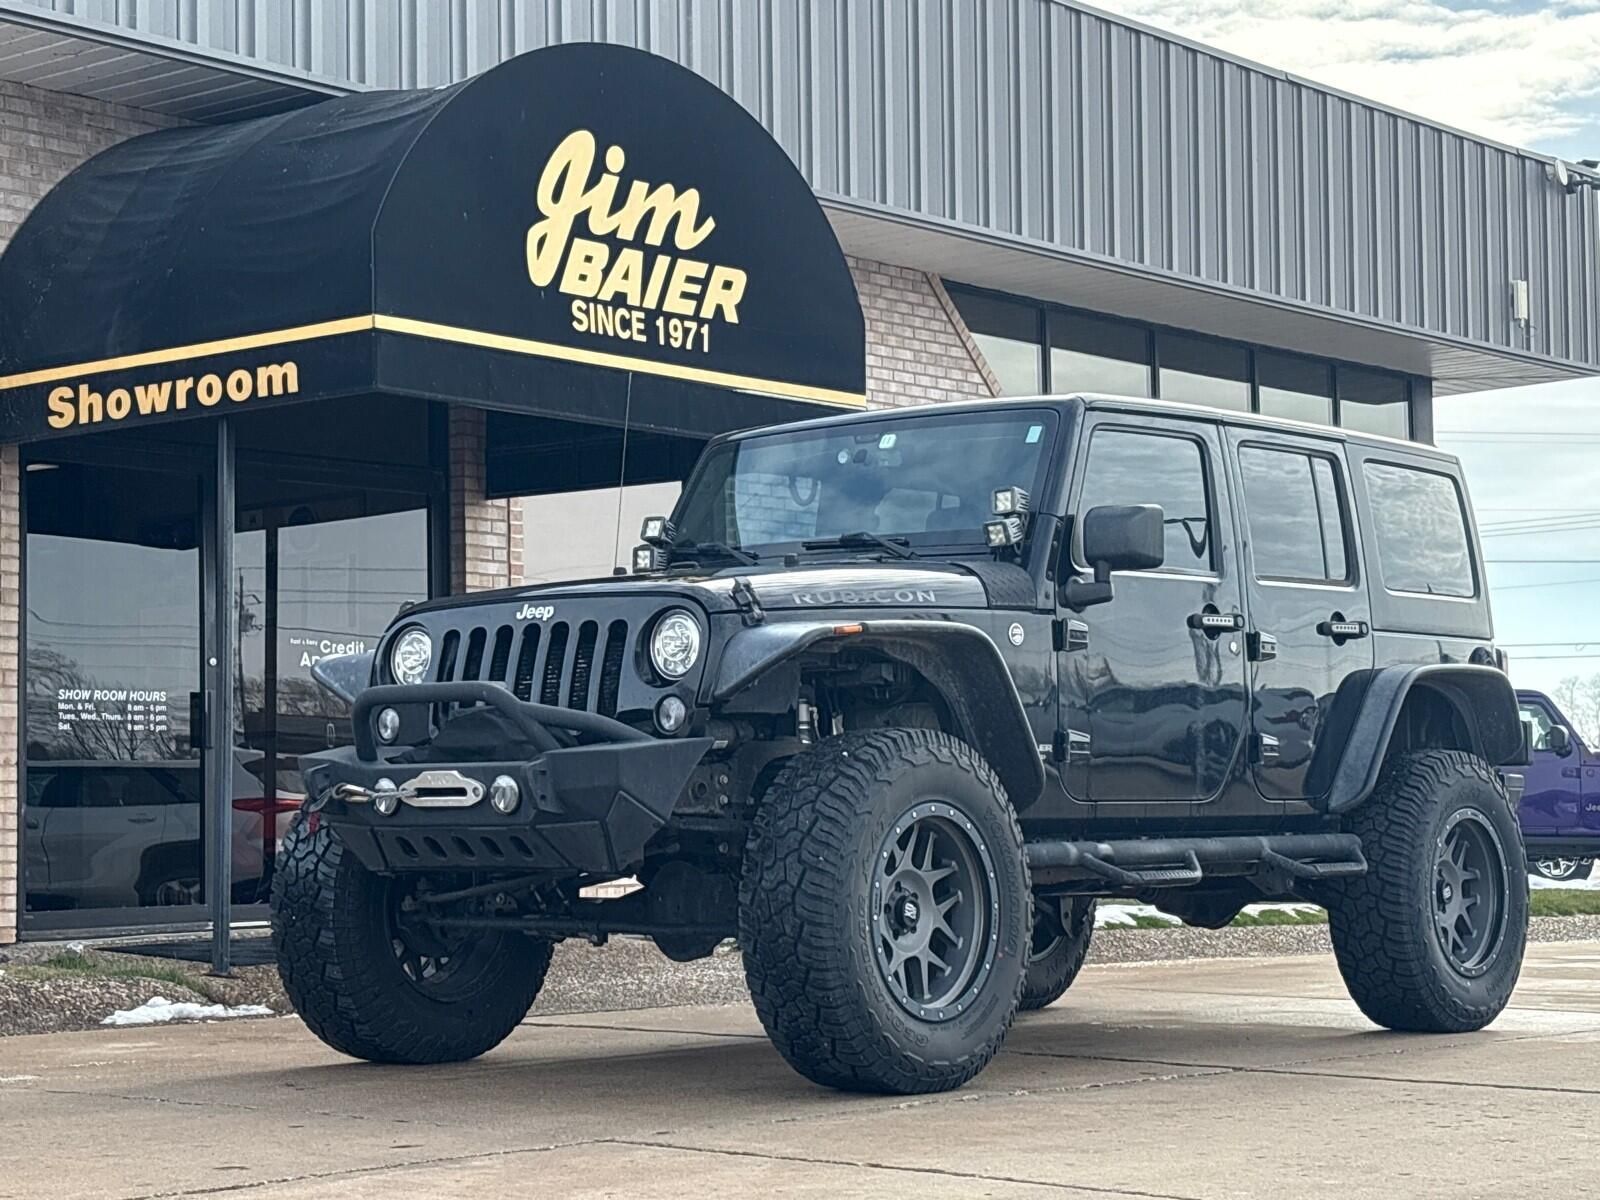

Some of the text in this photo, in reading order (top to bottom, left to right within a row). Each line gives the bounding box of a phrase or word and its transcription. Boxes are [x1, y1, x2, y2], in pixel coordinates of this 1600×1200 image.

[526, 129, 716, 287] Jim
[558, 237, 748, 324] BAIER
[571, 299, 710, 353] SINCE 1971
[47, 361, 299, 429] Showroom
[791, 589, 937, 605] RUBICON
[516, 603, 555, 621] Jeep
[320, 640, 365, 655] Credit
[58, 688, 167, 702] SHOW ROOM HOURS
[58, 702, 76, 710] Mon.
[84, 702, 96, 711] Fri.
[155, 704, 167, 712] pm
[155, 714, 167, 722] pm
[155, 724, 167, 732] pm
